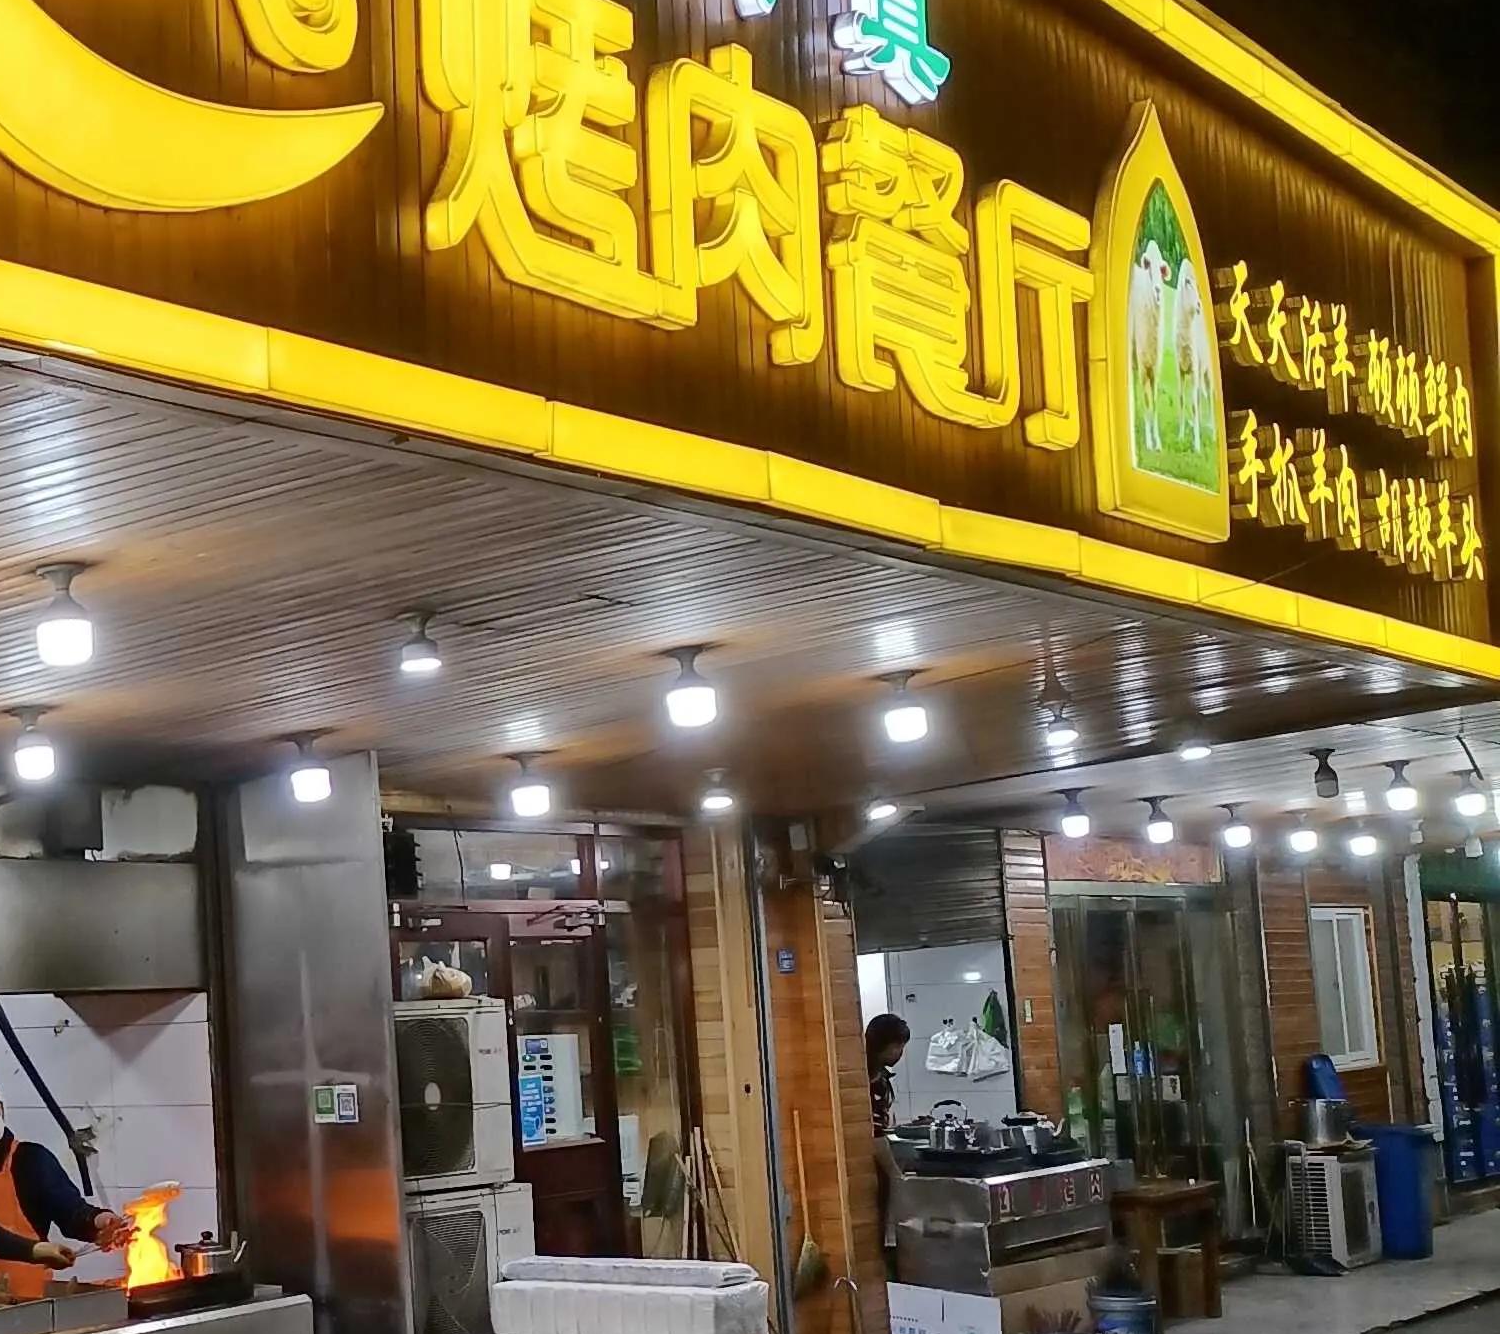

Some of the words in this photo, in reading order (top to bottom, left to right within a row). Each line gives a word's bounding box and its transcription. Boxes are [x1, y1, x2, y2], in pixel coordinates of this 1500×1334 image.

[1229, 259, 1356, 413] 天天活羊
[1368, 328, 1474, 457] 顿顿鲜肉
[1237, 408, 1362, 549] 手抓羊肉
[1375, 467, 1484, 580] 胡辣羊头
